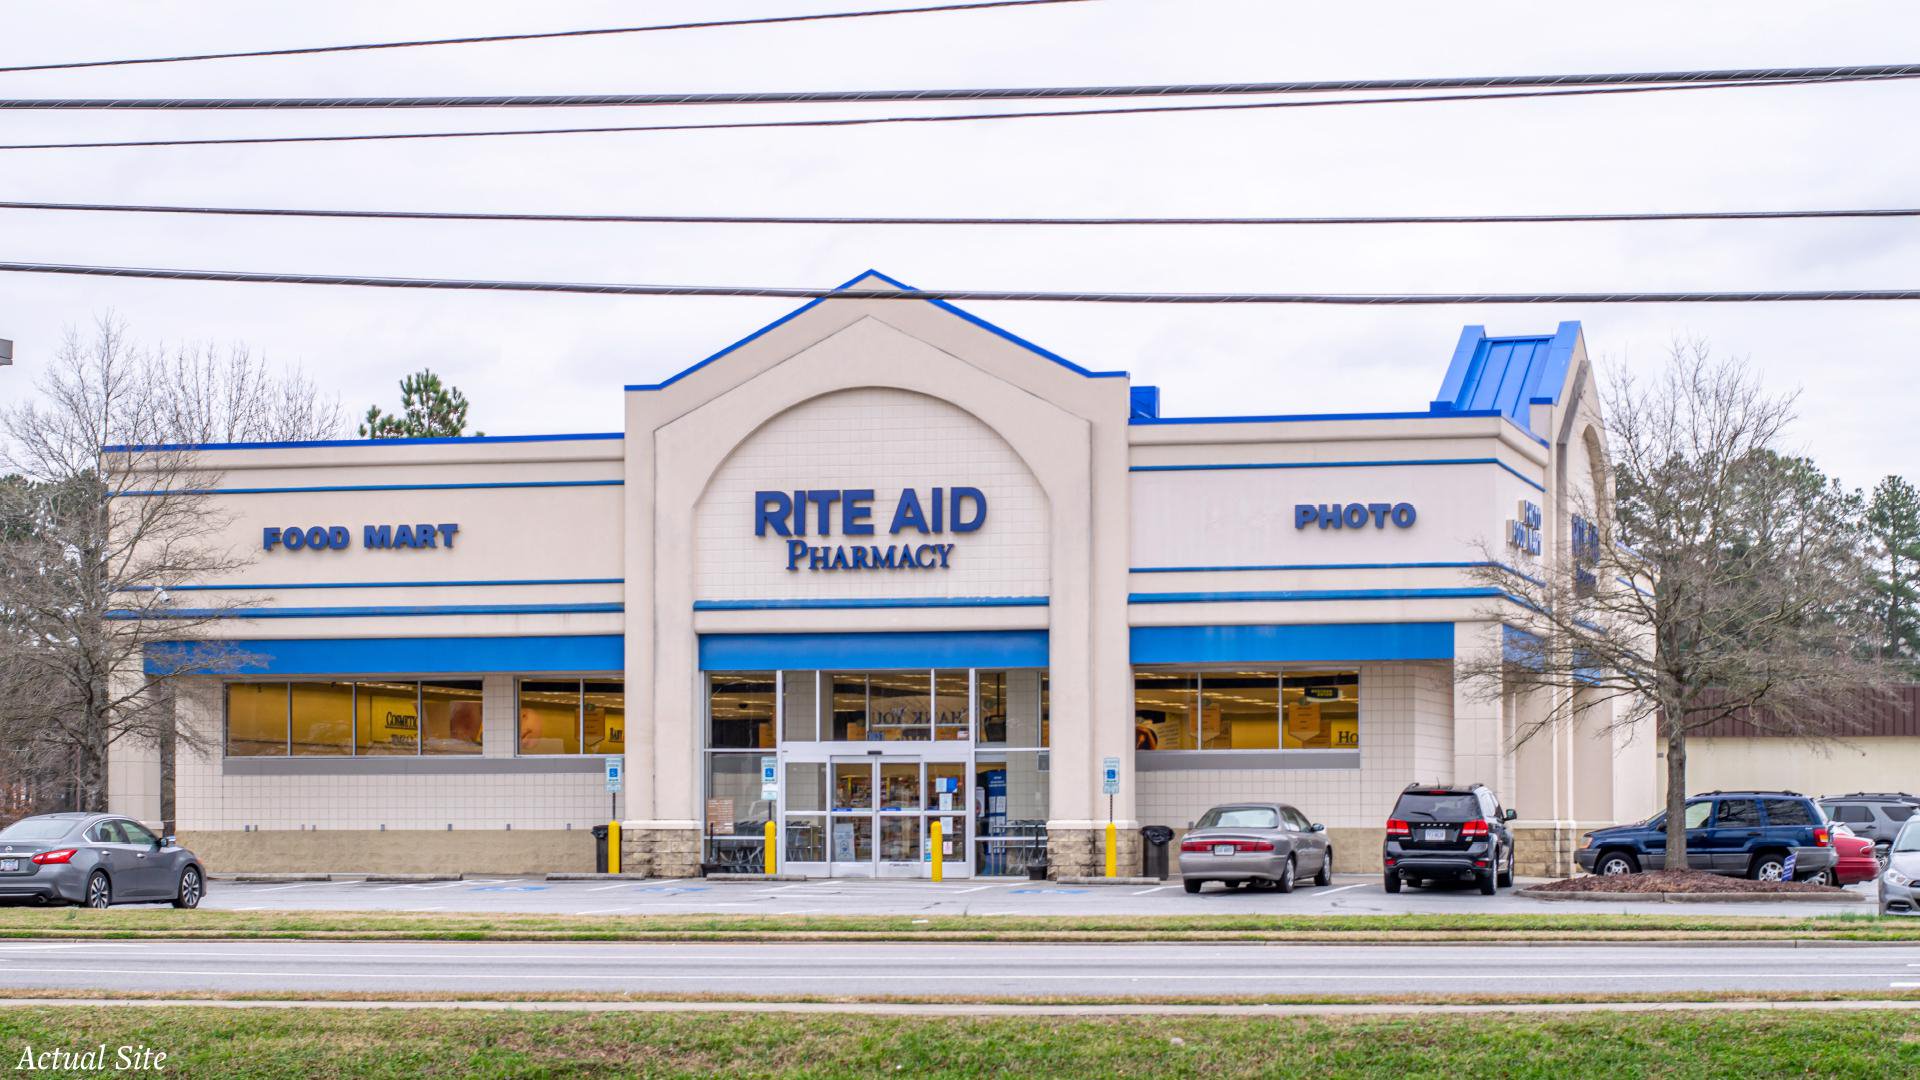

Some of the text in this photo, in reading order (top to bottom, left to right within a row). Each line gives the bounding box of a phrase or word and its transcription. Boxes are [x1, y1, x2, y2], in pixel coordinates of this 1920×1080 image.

[755, 487, 987, 536] RITE AID
[1294, 502, 1417, 529] PHOTO
[262, 522, 459, 551] FOOD MART
[786, 539, 954, 571] PHARMACY
